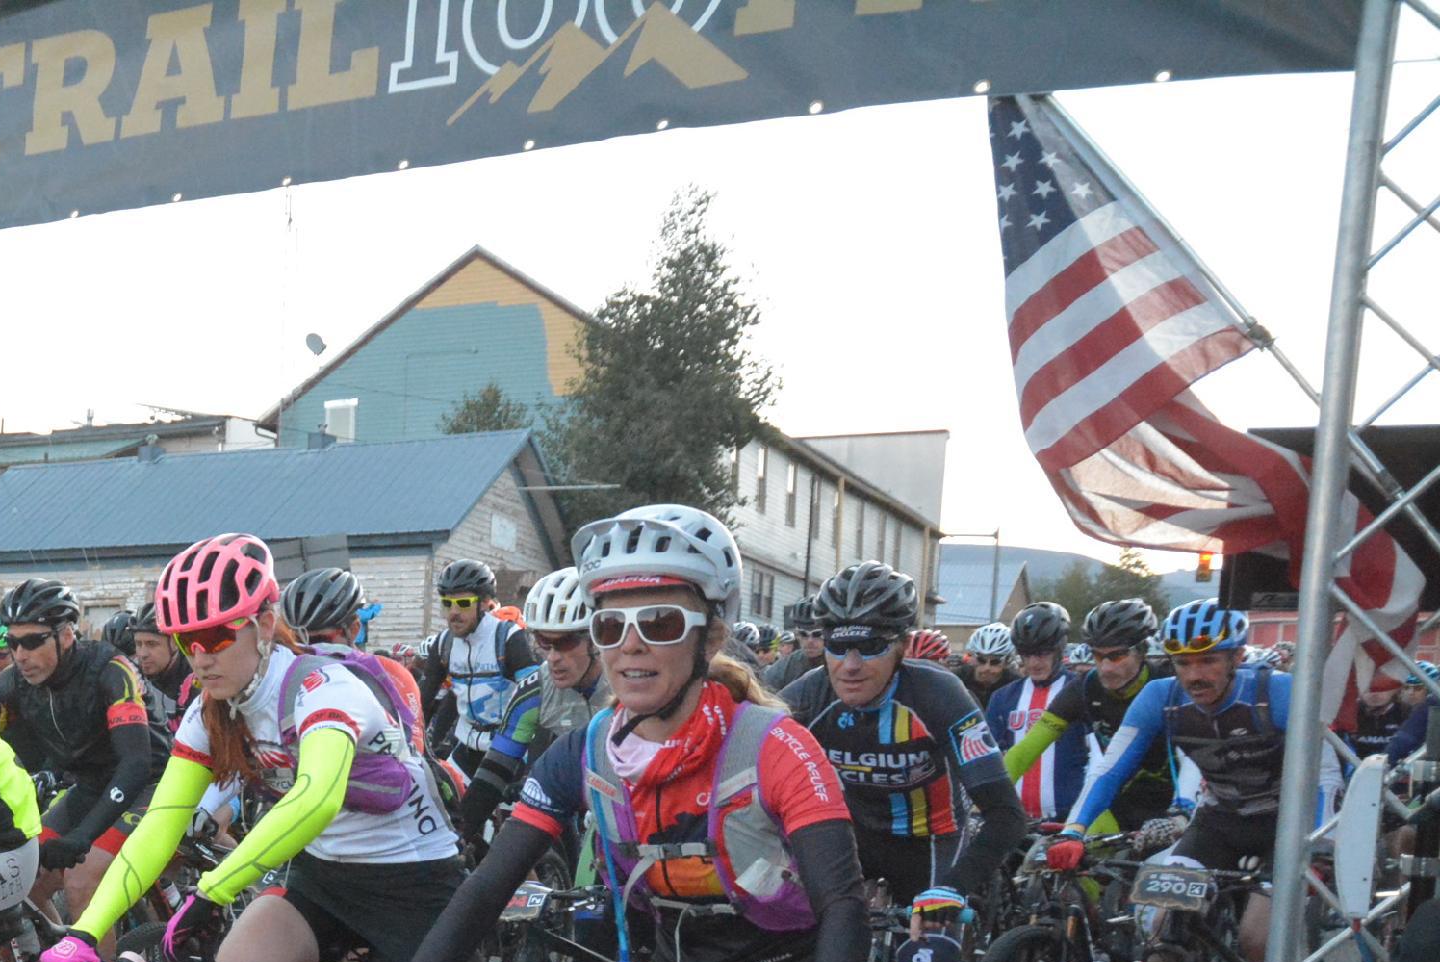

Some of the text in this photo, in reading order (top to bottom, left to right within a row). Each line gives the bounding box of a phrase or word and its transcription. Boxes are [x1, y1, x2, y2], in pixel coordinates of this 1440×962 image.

[1007, 707, 1046, 731] US
[771, 725, 809, 762] BICYCLE
[805, 760, 830, 803] RELIEF
[1145, 880, 1187, 895] 290
